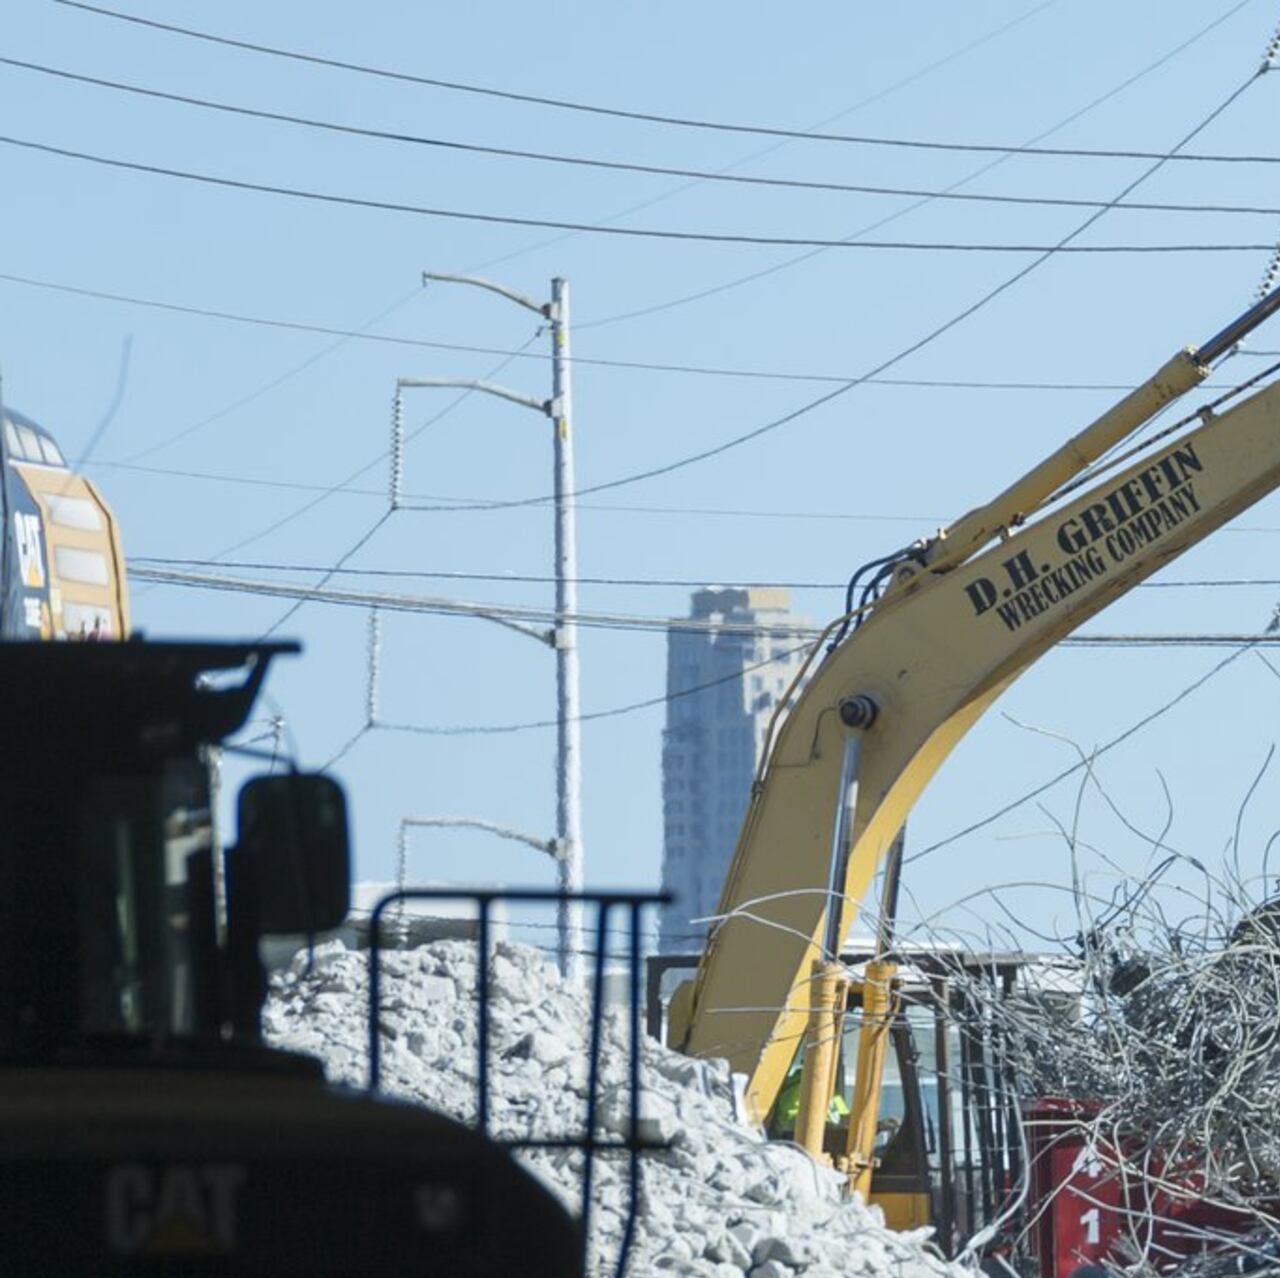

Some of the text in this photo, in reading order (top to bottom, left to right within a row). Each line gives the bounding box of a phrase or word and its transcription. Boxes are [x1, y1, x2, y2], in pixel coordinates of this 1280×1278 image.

[1056, 442, 1203, 555] GRIFFIN
[996, 483, 1201, 632] WRECKING COMPANY
[105, 1163, 247, 1256] CAT
